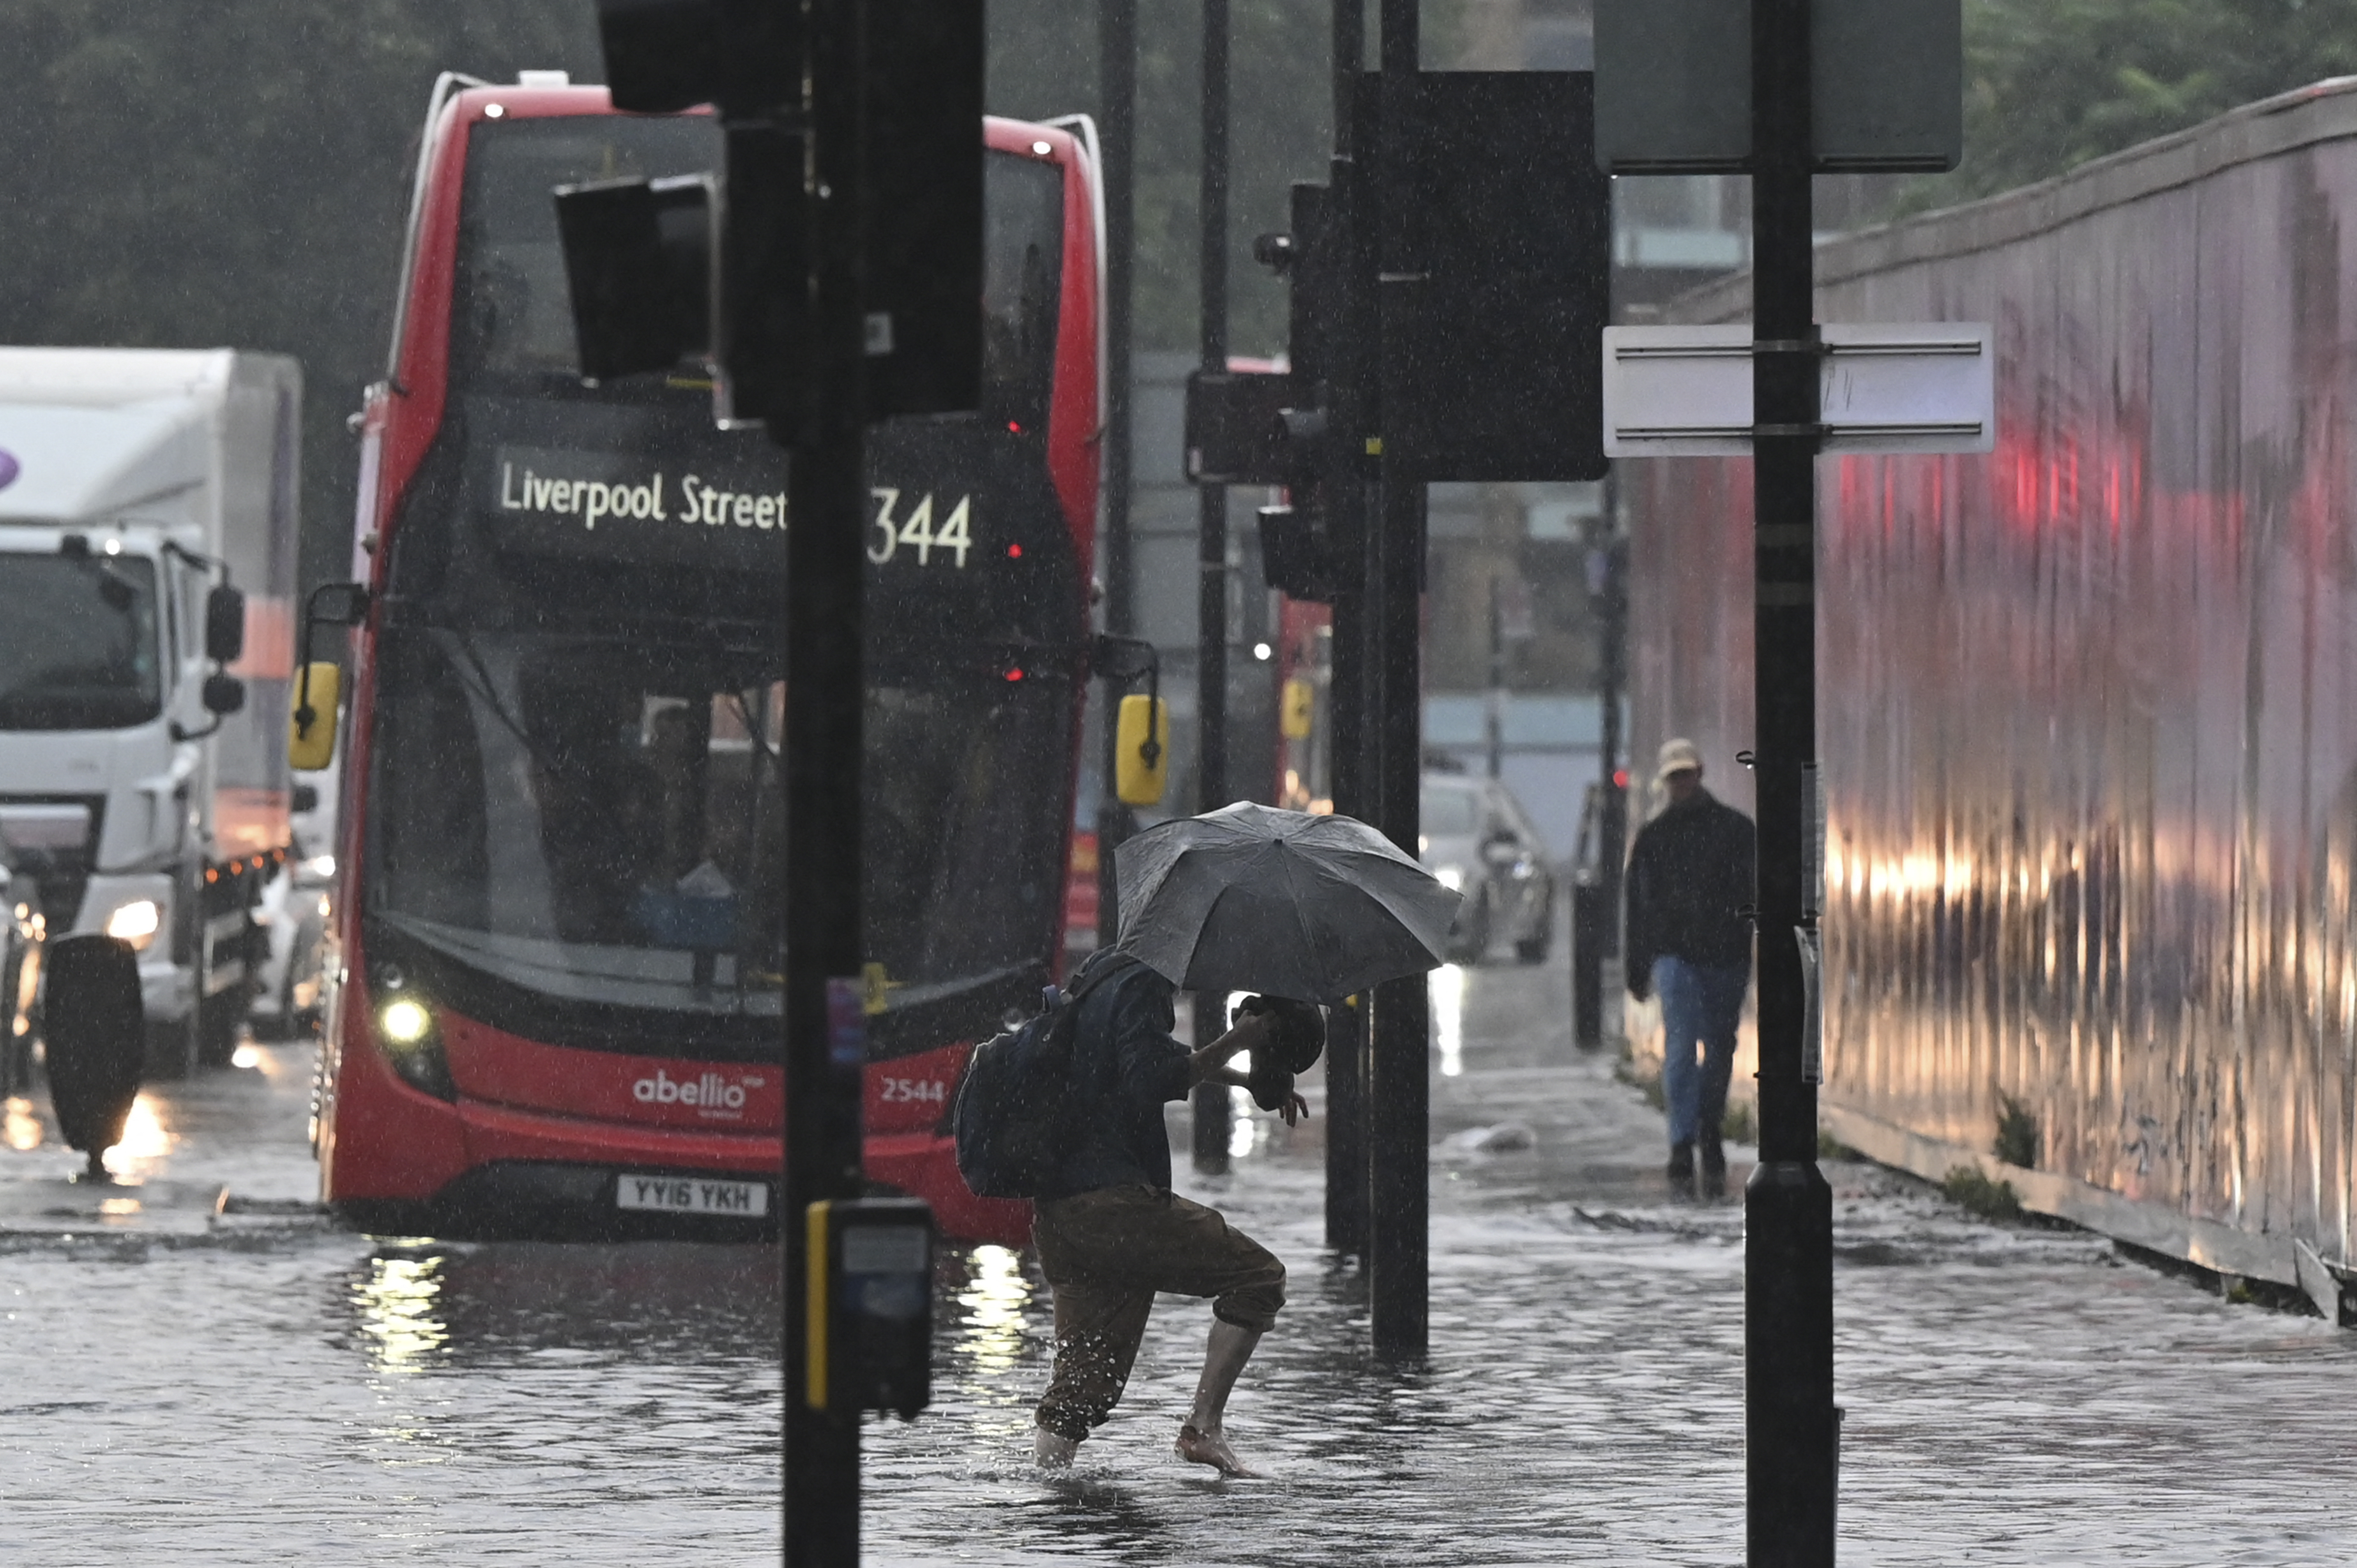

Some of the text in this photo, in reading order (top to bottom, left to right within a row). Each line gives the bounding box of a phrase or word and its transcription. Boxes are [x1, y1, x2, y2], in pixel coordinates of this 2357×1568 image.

[501, 462, 788, 531] Liverpool Street
[867, 487, 972, 568] 344
[633, 1069, 746, 1109] abellio
[881, 1077, 945, 1102] 2544
[635, 1180, 751, 1211] YY16 YKH
